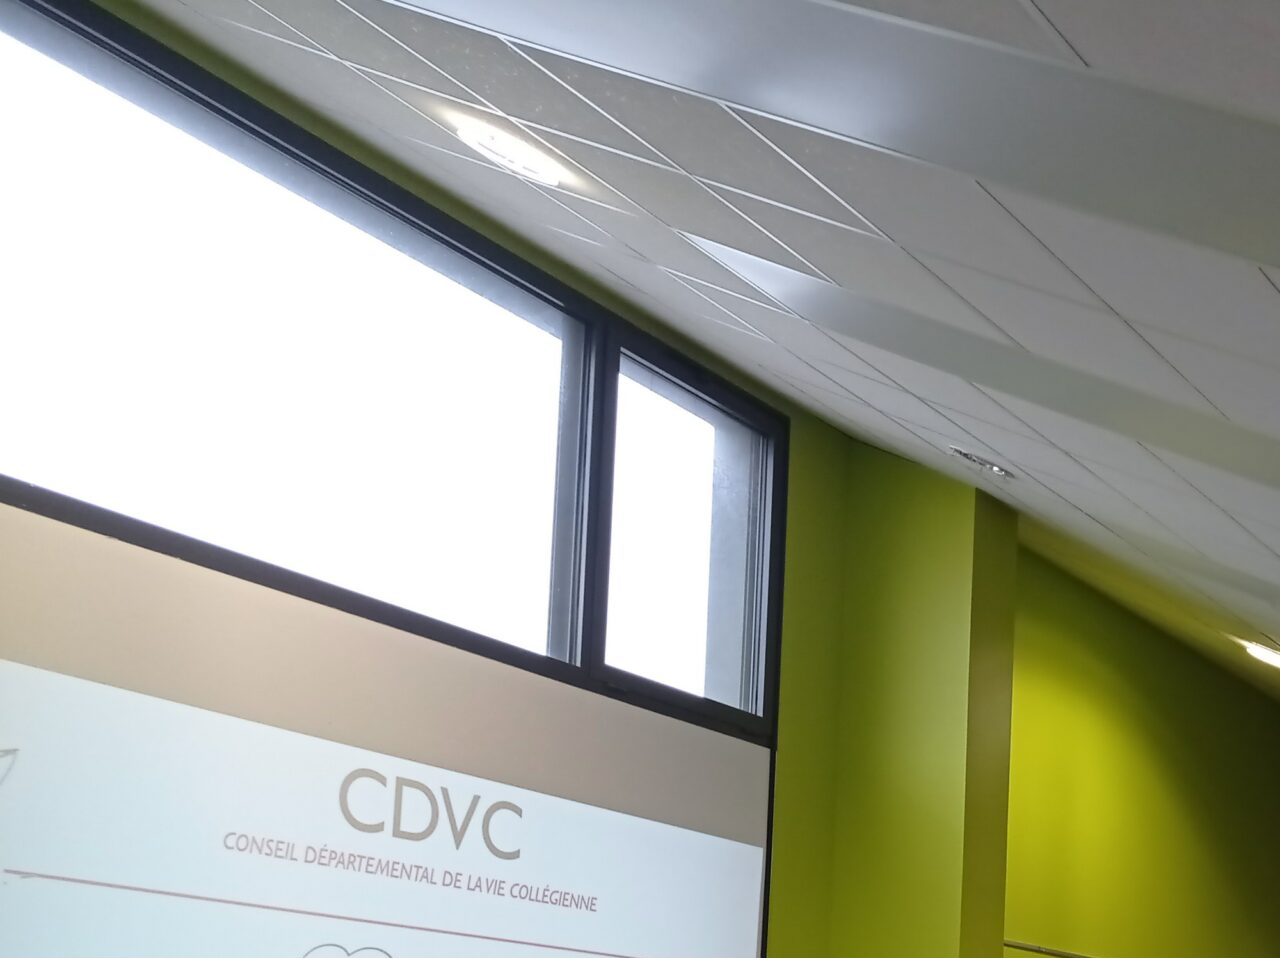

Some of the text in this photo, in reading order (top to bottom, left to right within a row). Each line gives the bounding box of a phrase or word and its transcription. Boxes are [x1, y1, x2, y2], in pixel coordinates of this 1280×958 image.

[339, 768, 522, 860] CDVC
[223, 832, 598, 912] CONSEIL DÉPARTEMENTAL DE LA VIE COLLÉGIENNE
